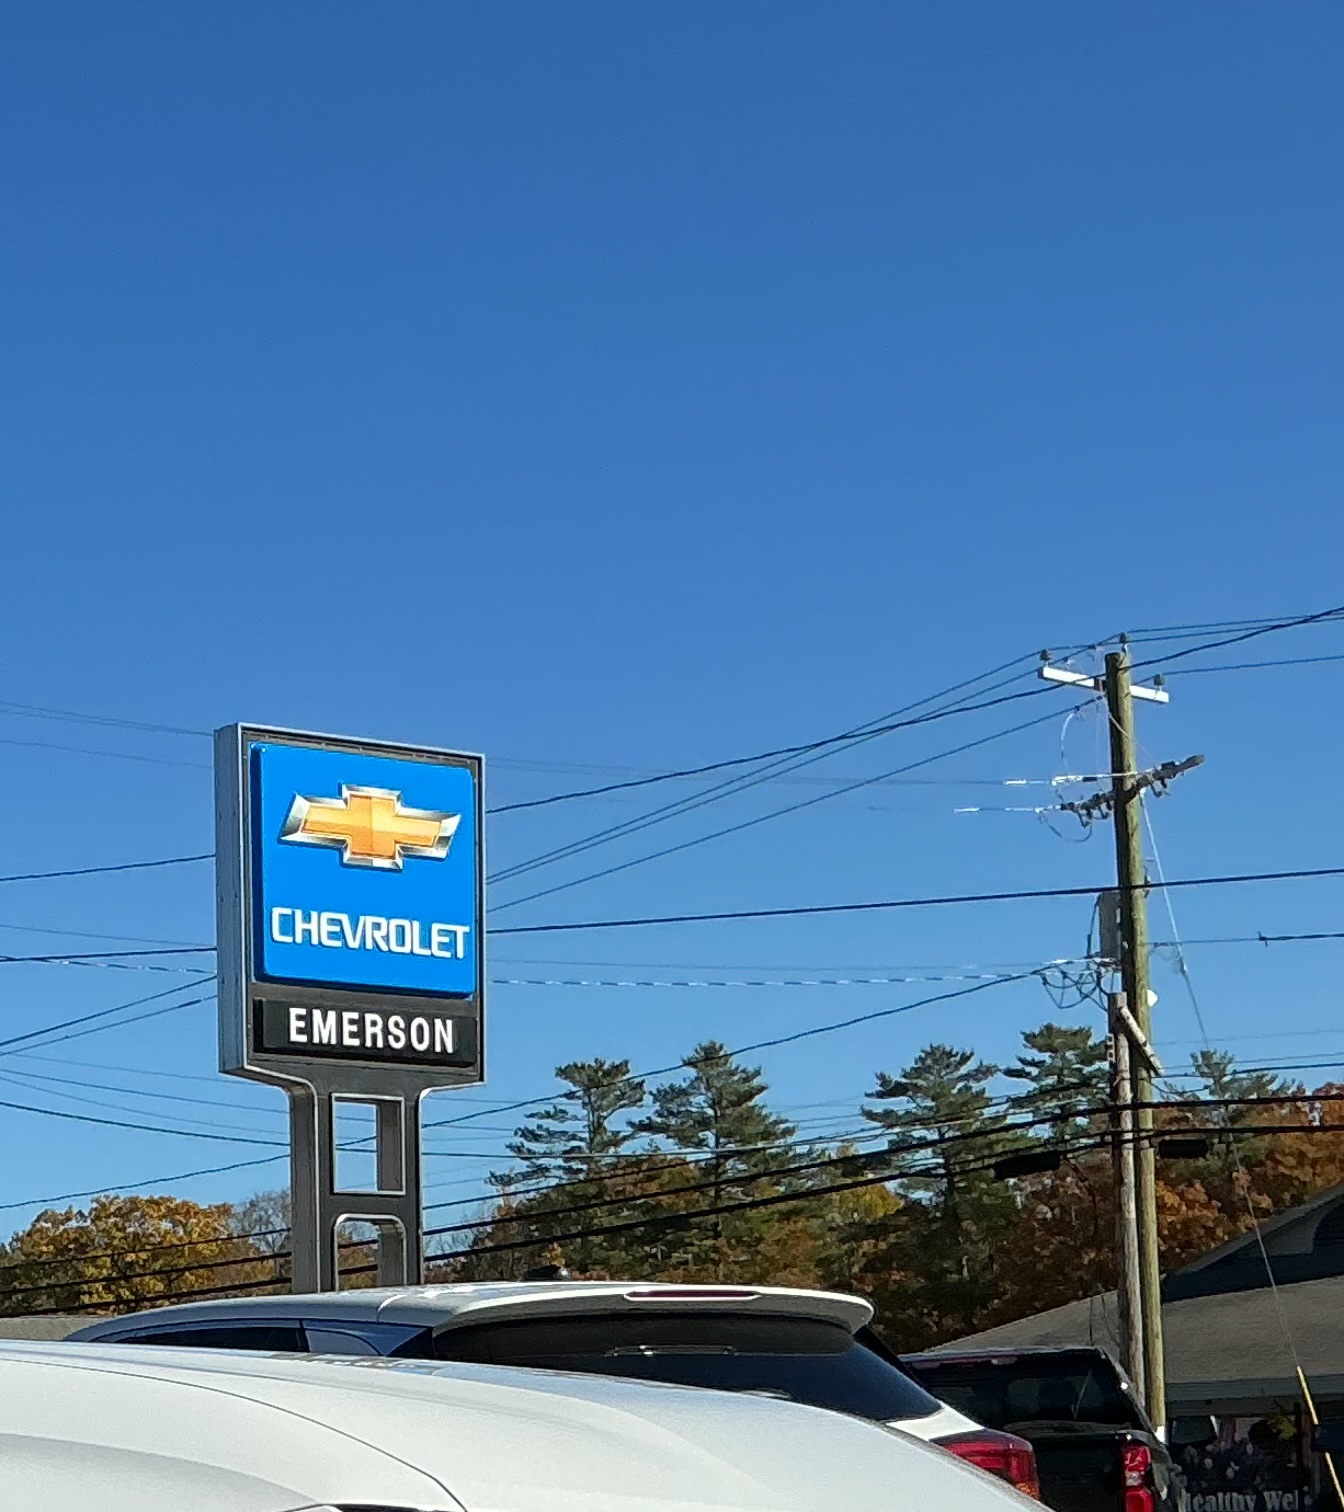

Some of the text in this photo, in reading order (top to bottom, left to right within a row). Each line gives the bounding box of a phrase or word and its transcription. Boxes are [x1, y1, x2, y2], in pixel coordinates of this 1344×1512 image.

[271, 906, 471, 960] CHEVROLET
[288, 1006, 455, 1054] EMERSON
[1262, 1489, 1299, 1512] Wel
